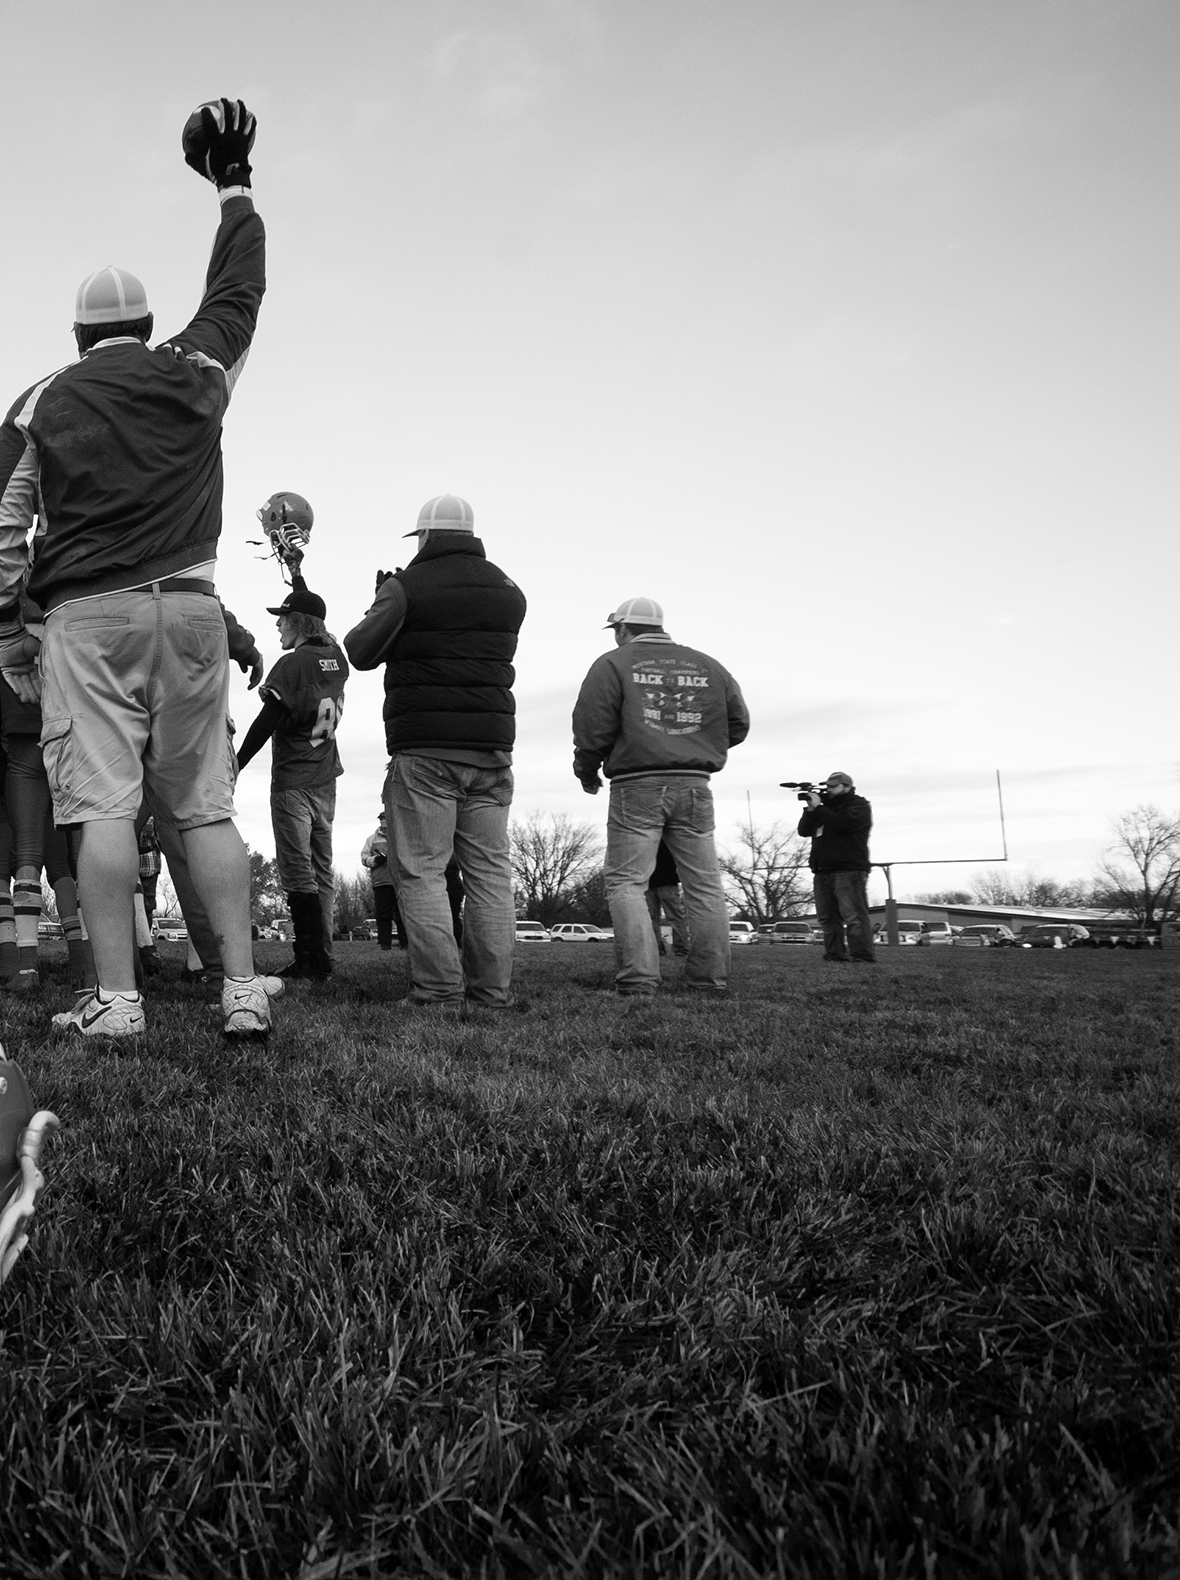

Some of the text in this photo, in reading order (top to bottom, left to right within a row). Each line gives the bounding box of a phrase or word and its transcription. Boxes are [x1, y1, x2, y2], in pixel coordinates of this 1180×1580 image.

[318, 658, 340, 672] SMITH
[632, 673, 664, 685] BACK
[677, 676, 710, 688] BACK
[676, 711, 703, 724] 1992
